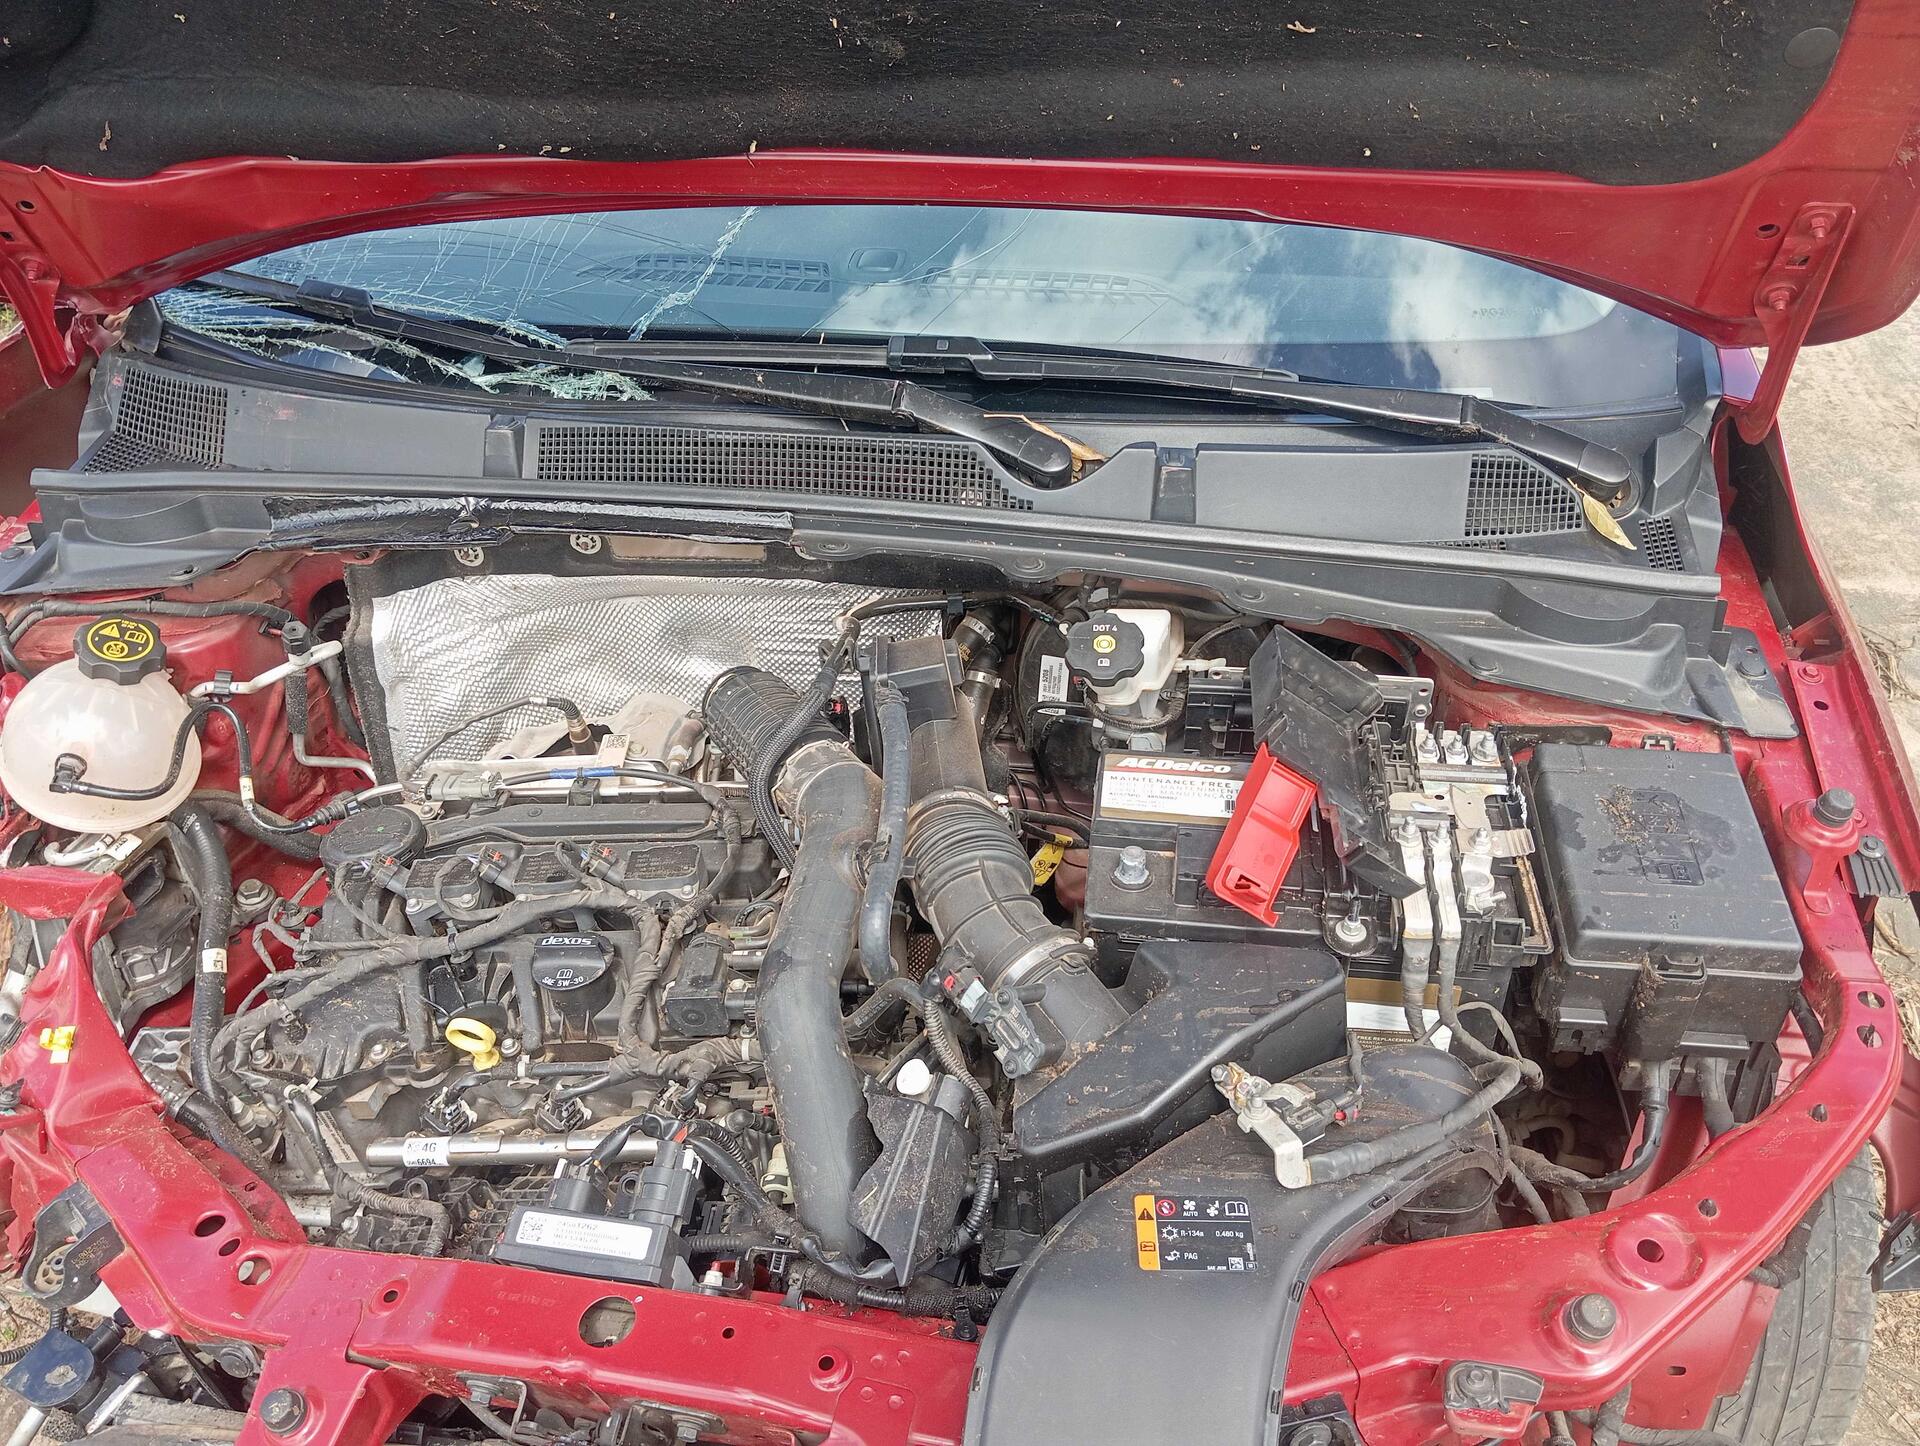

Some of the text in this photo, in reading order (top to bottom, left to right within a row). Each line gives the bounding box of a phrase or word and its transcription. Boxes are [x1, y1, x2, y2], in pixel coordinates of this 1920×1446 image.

[1093, 624, 1118, 632] DOT 4
[1116, 757, 1232, 774] ACDelco
[1110, 775, 1196, 786] MAINTENANCE
[1201, 781, 1232, 789] FREE
[541, 935, 592, 946] dexos
[541, 976, 584, 987] SAE 5W-30
[1180, 1229, 1204, 1237] R-134a
[1235, 1231, 1244, 1239] kg
[1184, 1252, 1198, 1260] PAG
